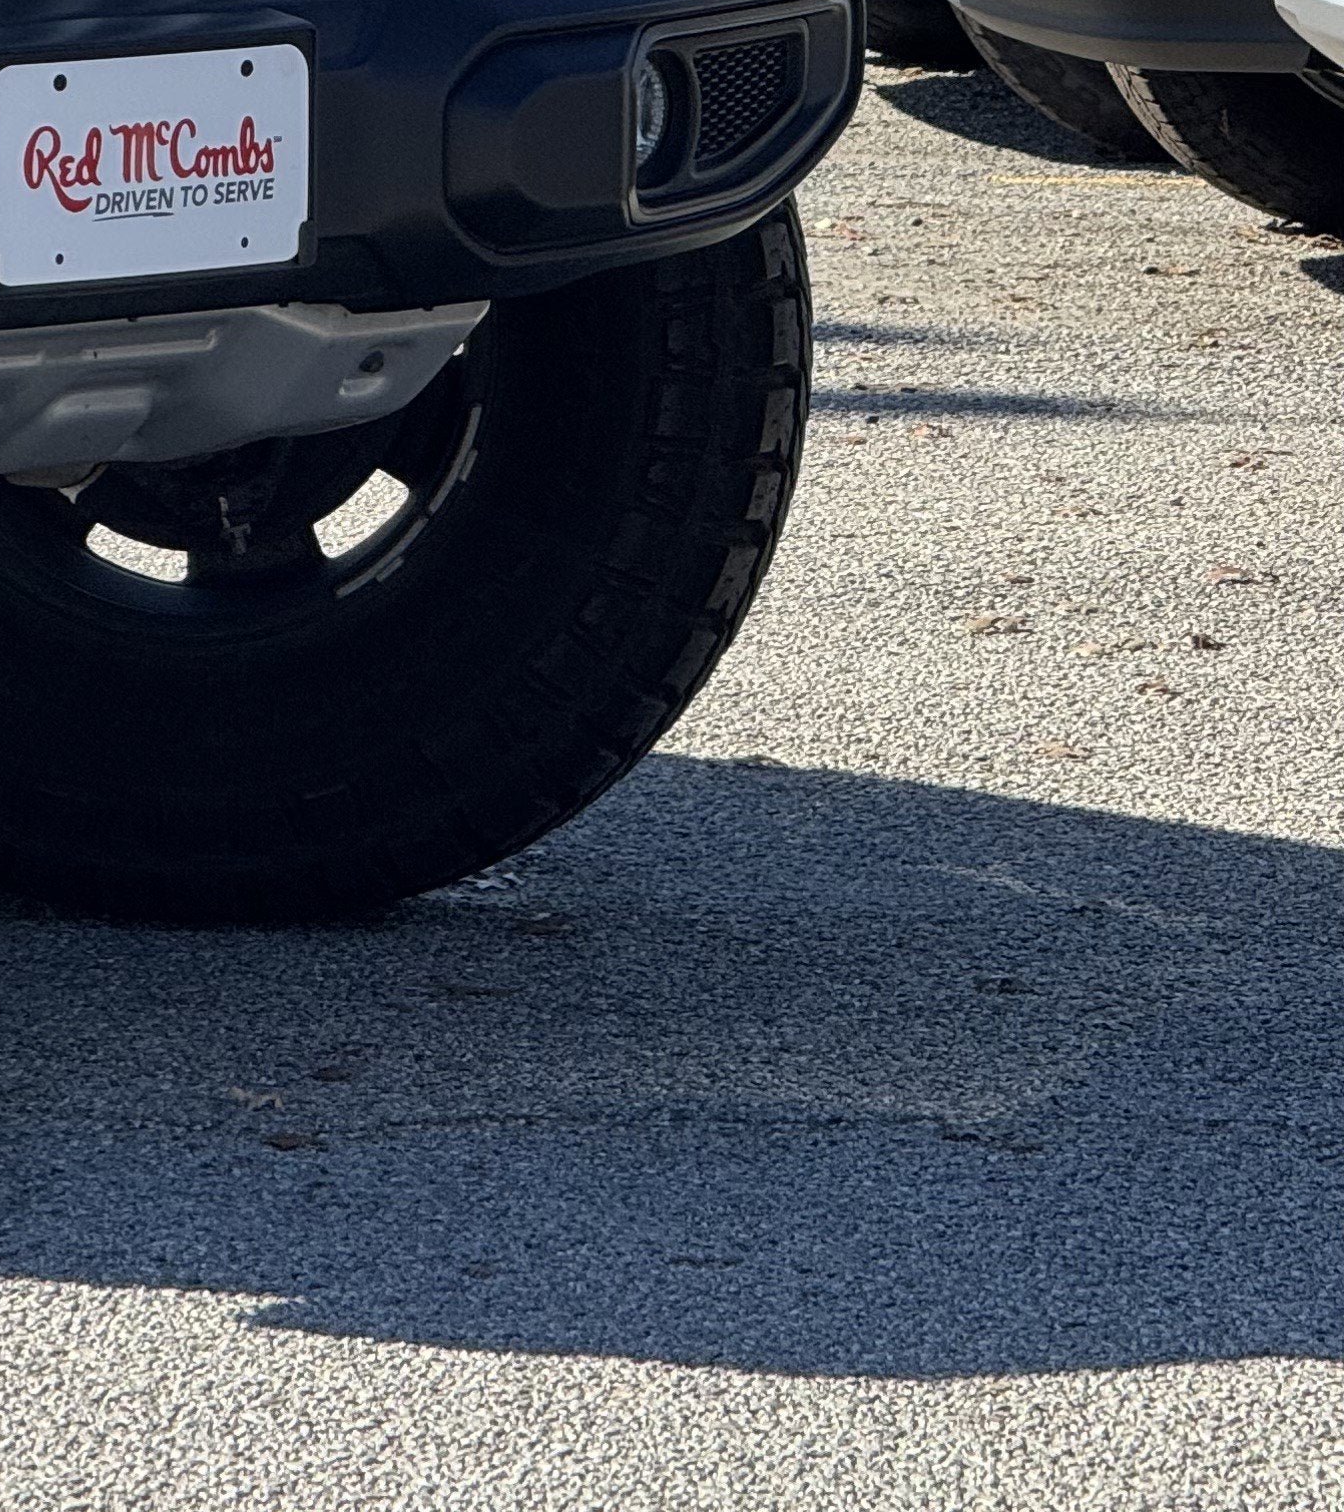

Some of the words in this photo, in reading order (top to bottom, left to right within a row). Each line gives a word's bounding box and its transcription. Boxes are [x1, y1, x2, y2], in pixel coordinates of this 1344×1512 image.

[22, 125, 102, 214] Red
[109, 115, 275, 183] McCombs
[94, 186, 175, 216] DRIVEN
[180, 183, 209, 208] TO
[213, 177, 276, 205] SERVE
